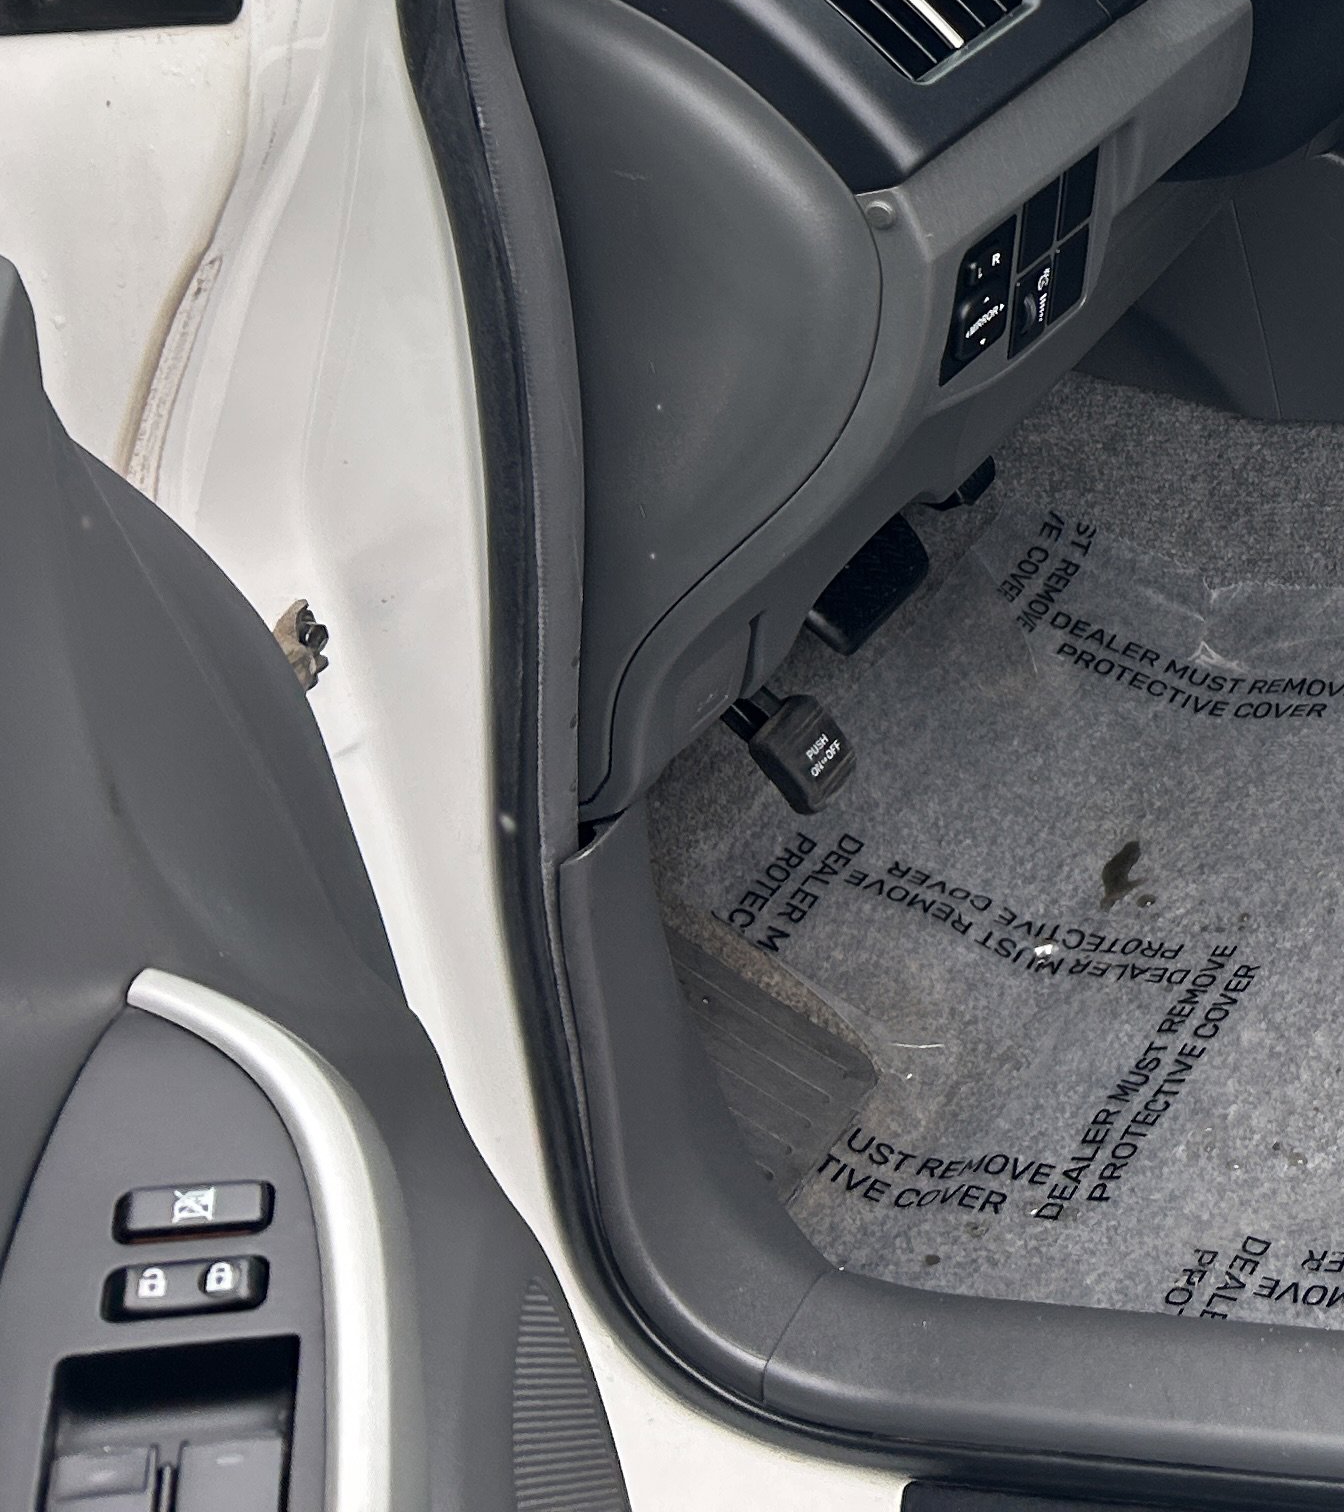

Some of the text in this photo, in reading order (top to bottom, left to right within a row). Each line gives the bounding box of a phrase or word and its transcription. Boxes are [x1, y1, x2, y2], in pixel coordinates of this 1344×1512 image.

[991, 252, 1001, 267] R
[1016, 558, 1081, 633] REMOVE
[1050, 611, 1161, 668] DEALER
[1164, 659, 1246, 694] MUST
[1056, 643, 1328, 719] PROTECTIVE COVER
[806, 733, 829, 760] PUSH
[777, 833, 864, 924] DEALER
[887, 861, 1185, 961] PROTECTIVE COVER
[844, 869, 1192, 985] DEALER MUST REMOVE
[1035, 944, 1238, 1221] DEALER MUST REMOVE
[1086, 964, 1261, 1202] PROTECTIVE COVER
[817, 1153, 1008, 1215] TIVE COVER
[847, 1128, 1056, 1186] UST REMOVE
